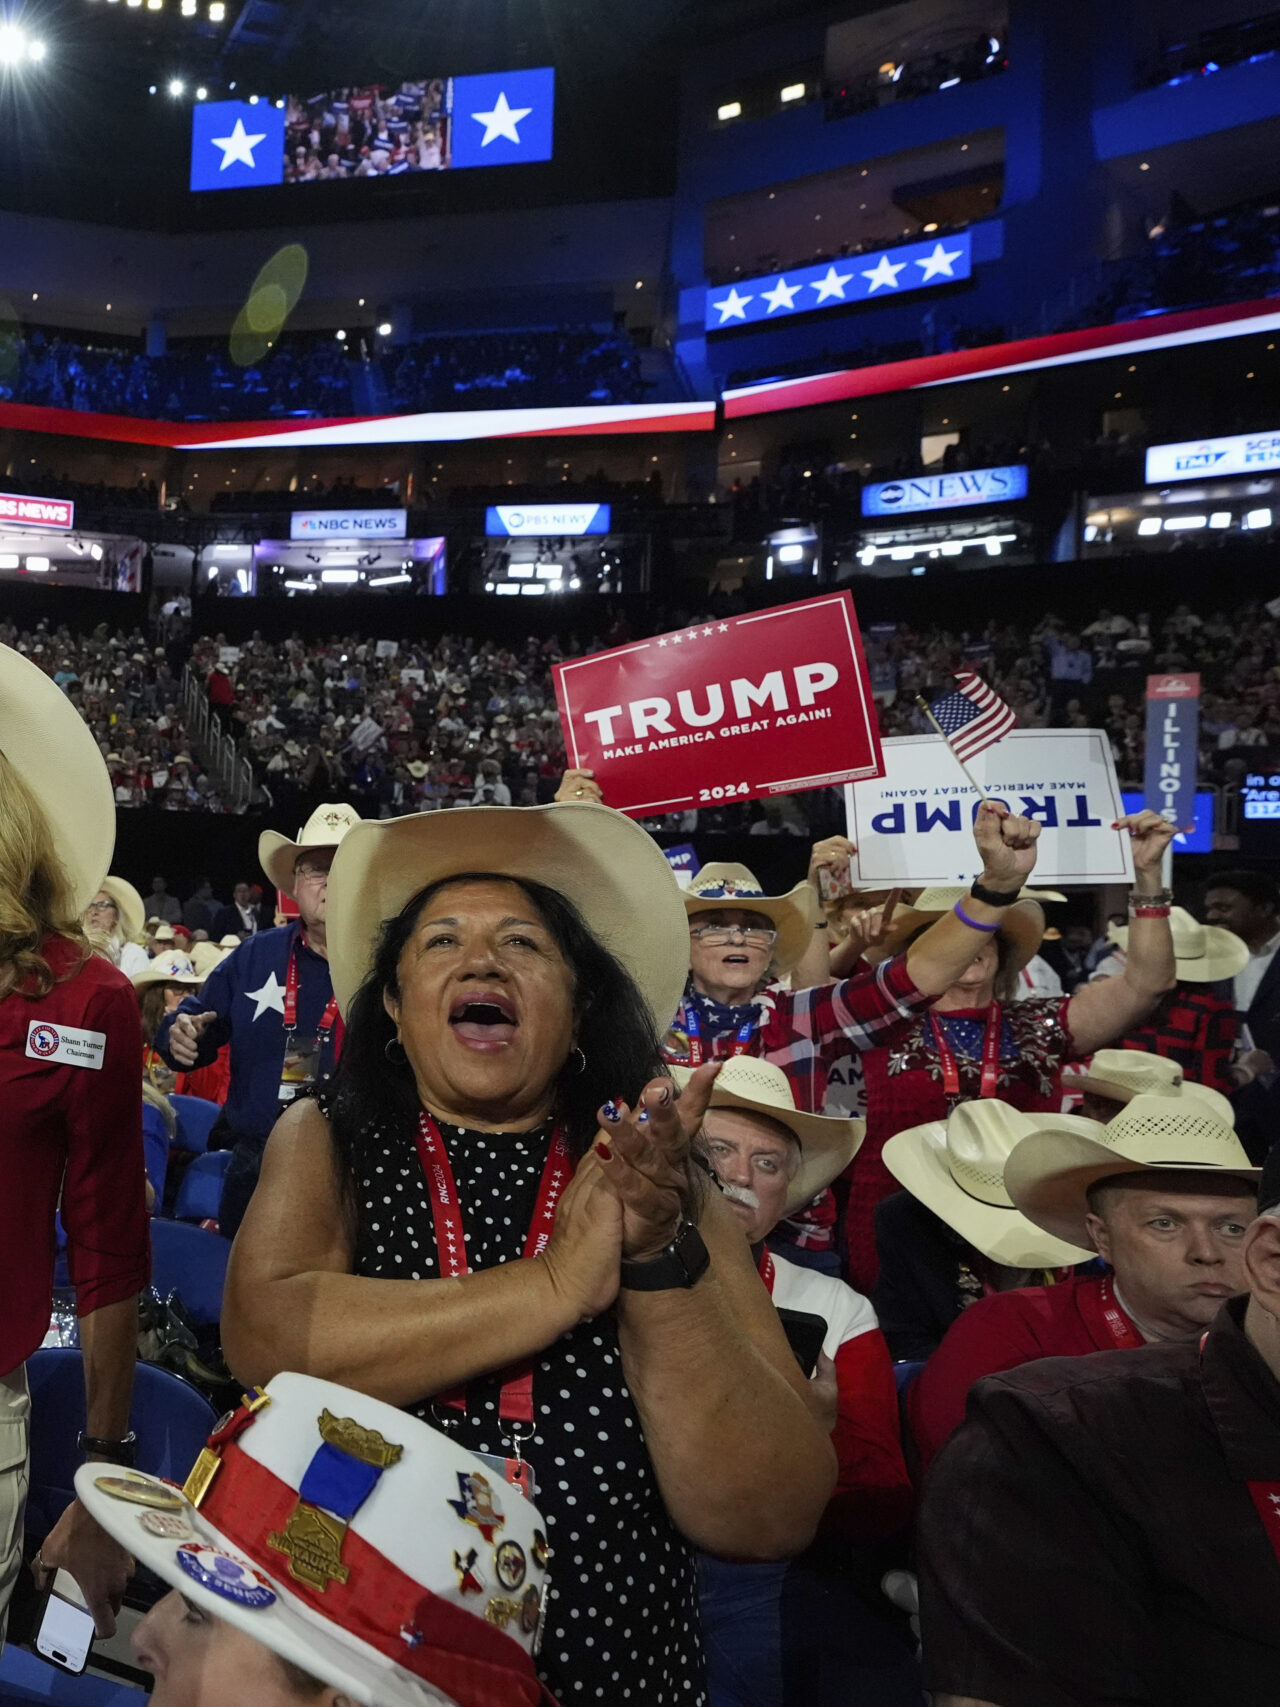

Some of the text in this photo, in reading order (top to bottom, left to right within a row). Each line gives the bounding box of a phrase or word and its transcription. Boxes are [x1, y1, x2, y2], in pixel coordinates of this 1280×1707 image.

[908, 471, 1008, 502] NEWS
[18, 502, 68, 521] NEWS
[526, 514, 588, 525] PBS NEWS
[318, 518, 398, 531] NBC NEWS
[584, 661, 839, 747] TRUMP
[603, 707, 833, 760] MAKE AMERICA GREAT AGAIN!
[1158, 702, 1181, 823] ILLINOIS
[880, 781, 1087, 798] MAKE AMERICA GREAT AGAIN!
[1246, 772, 1265, 787] in
[698, 781, 751, 802] 2024
[871, 795, 1102, 835] TRMP
[686, 1011, 697, 1031] TEXAS
[60, 1035, 104, 1051] Shann Turner
[690, 1041, 701, 1063] TEXAS
[66, 1048, 95, 1060] Chairman
[433, 1164, 450, 1205] RNC2024
